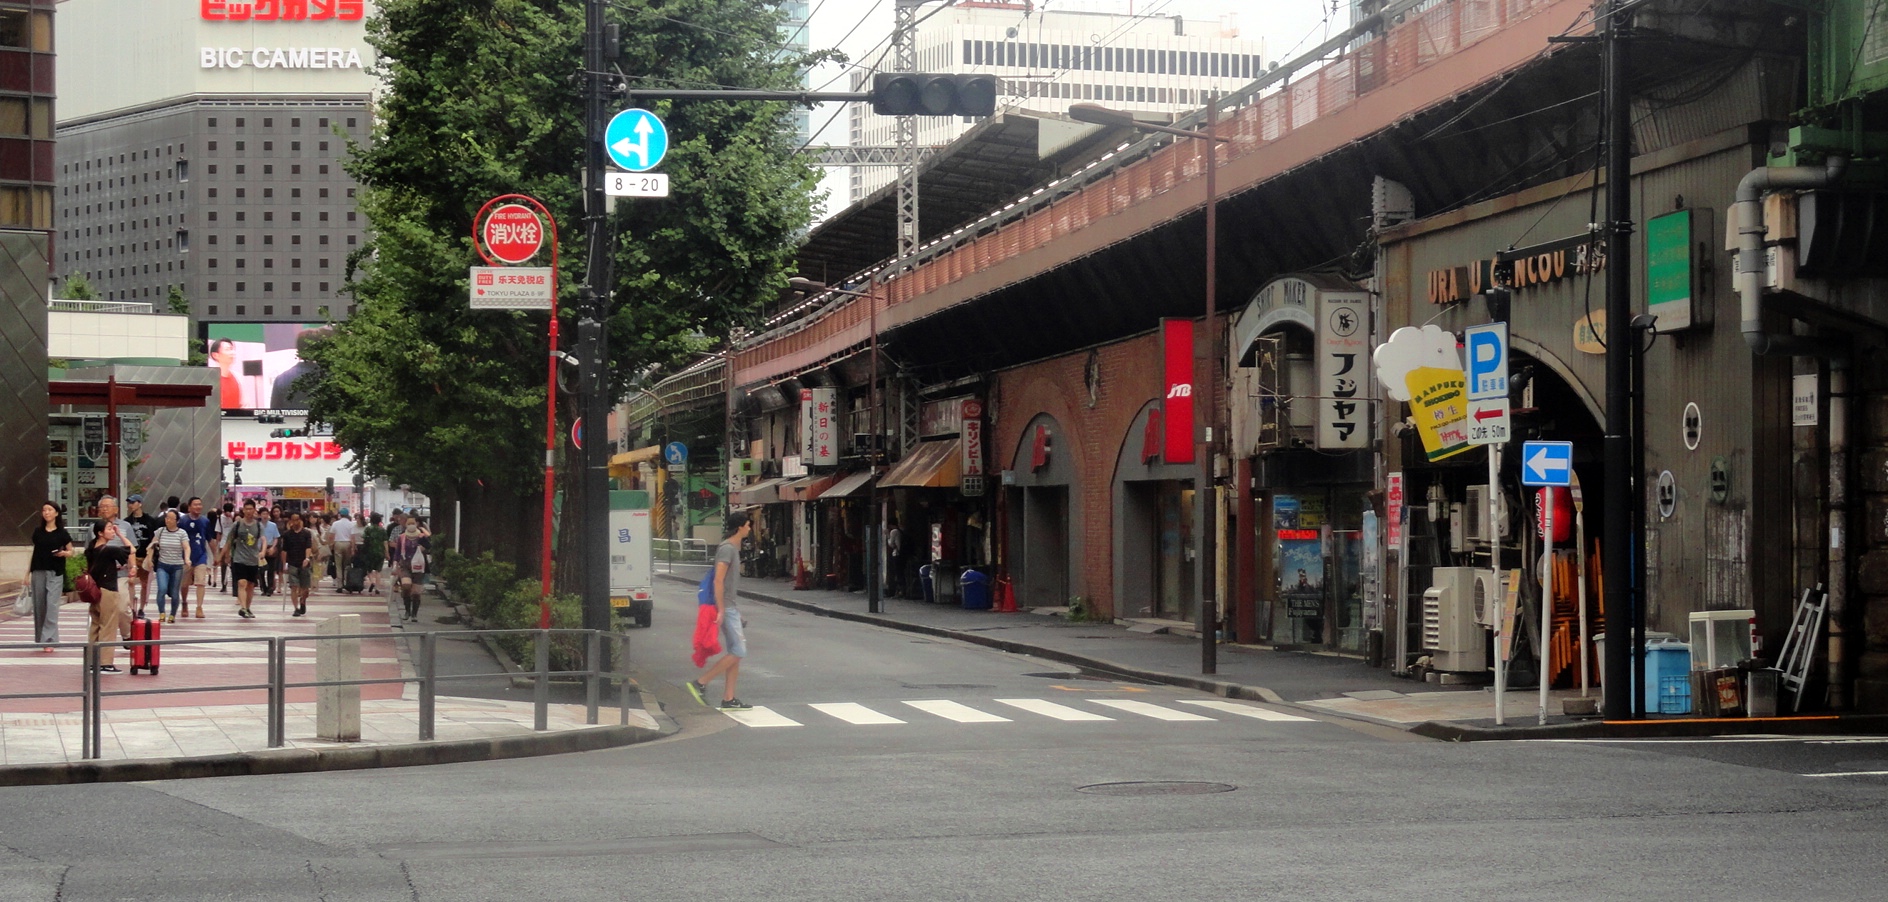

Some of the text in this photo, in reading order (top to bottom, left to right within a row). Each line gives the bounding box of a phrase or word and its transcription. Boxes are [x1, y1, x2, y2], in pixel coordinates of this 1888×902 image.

[201, 47, 363, 69] BIC CAMERA
[494, 212, 532, 220] FIRE HYDRANT
[490, 222, 538, 245] 消火栓
[498, 275, 545, 285] 乐天免税店
[1470, 331, 1502, 394] P
[1166, 383, 1192, 399] JTB
[1332, 353, 1357, 442] フジヤマ
[1414, 380, 1465, 404] MANPUKU
[1471, 426, 1488, 440] この先
[1491, 424, 1506, 438] 50m
[227, 441, 342, 460] ビックカメラ
[967, 421, 980, 475] キリンビール
